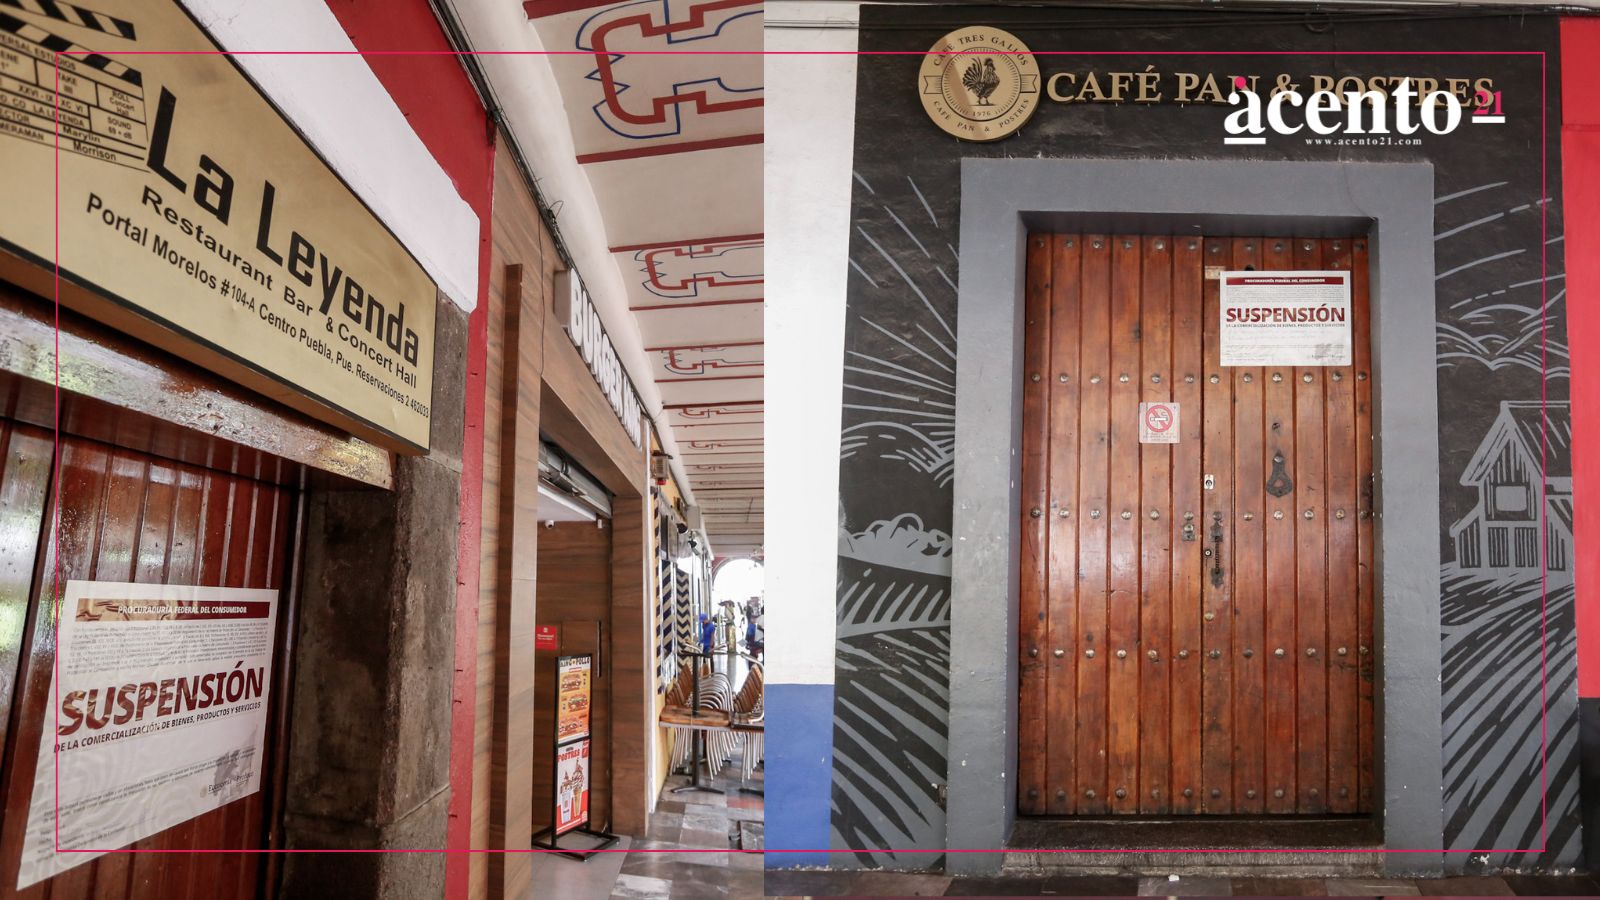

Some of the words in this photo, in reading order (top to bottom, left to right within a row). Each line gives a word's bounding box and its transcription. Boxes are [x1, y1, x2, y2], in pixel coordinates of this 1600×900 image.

[958, 34, 984, 45] TRES
[991, 36, 1029, 66] GALLOS
[1047, 65, 1162, 103] CAFÉ
[33, 104, 44, 115] LA
[47, 109, 85, 128] LEYENDA
[107, 116, 132, 131] SOUND
[957, 122, 976, 132] PAN
[998, 99, 1030, 128] POSTRES
[62, 125, 101, 143] Marylin
[73, 139, 117, 161] Morrison
[147, 85, 235, 226] La
[256, 180, 420, 368] Leyenda
[86, 192, 149, 247] Portal
[152, 234, 217, 290] Morelos
[259, 303, 297, 338] Centro
[299, 328, 334, 364] Puebla,
[335, 351, 354, 374] Pue.
[355, 363, 405, 404] Reservaciones
[142, 185, 273, 292] Restaurant
[284, 285, 313, 317] Bar
[326, 316, 334, 334] &
[338, 323, 393, 373] Concert
[396, 362, 417, 389] Hall
[1226, 303, 1345, 323] SUSPENSIÓN
[174, 605, 199, 614] FEDERAL
[200, 605, 211, 614] DEL
[211, 606, 247, 614] CONSUMIDOR
[58, 660, 265, 736] SUSPENSIÓN
[53, 742, 66, 753] DE
[67, 739, 79, 750] LA
[161, 720, 170, 730] DE
[171, 715, 195, 727] BIENES,
[196, 708, 230, 722] PRODUCTOS
[235, 701, 261, 714] SERVICIOS
